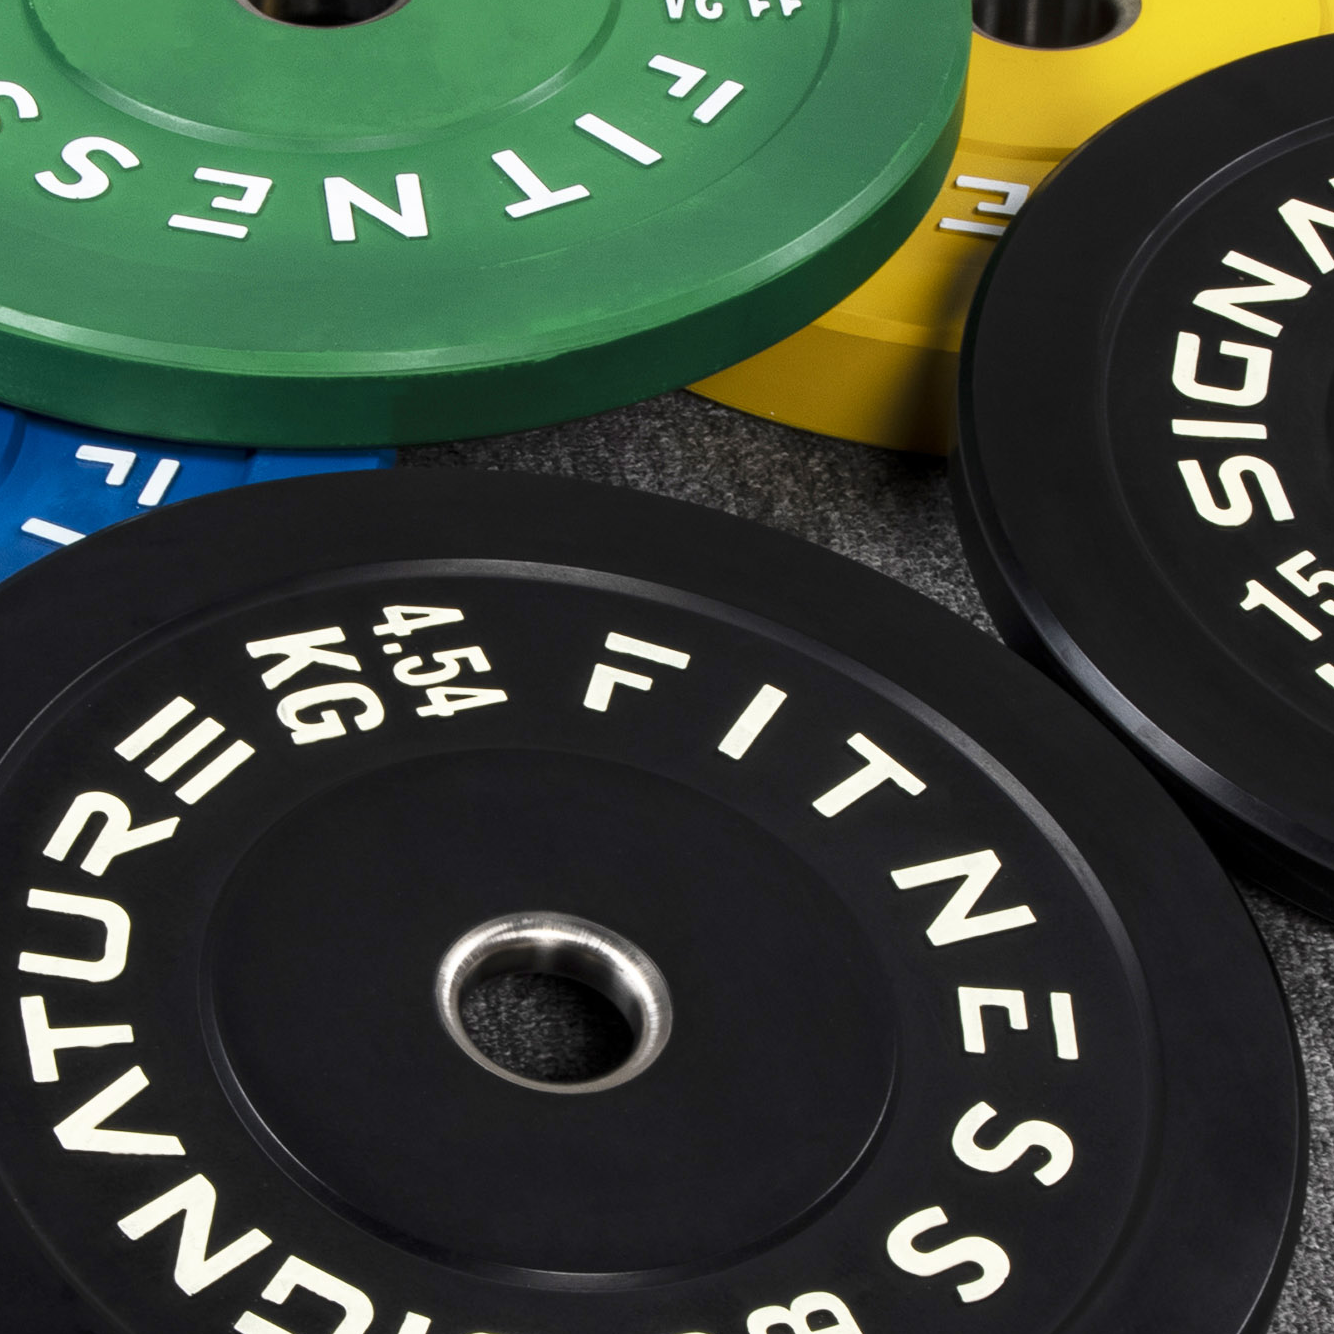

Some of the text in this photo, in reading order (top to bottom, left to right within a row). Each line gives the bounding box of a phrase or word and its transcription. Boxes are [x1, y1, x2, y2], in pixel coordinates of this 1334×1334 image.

[245, 626, 385, 745] KG
[373, 605, 507, 718] 4.54
[584, 632, 1080, 1304] FITNESS
